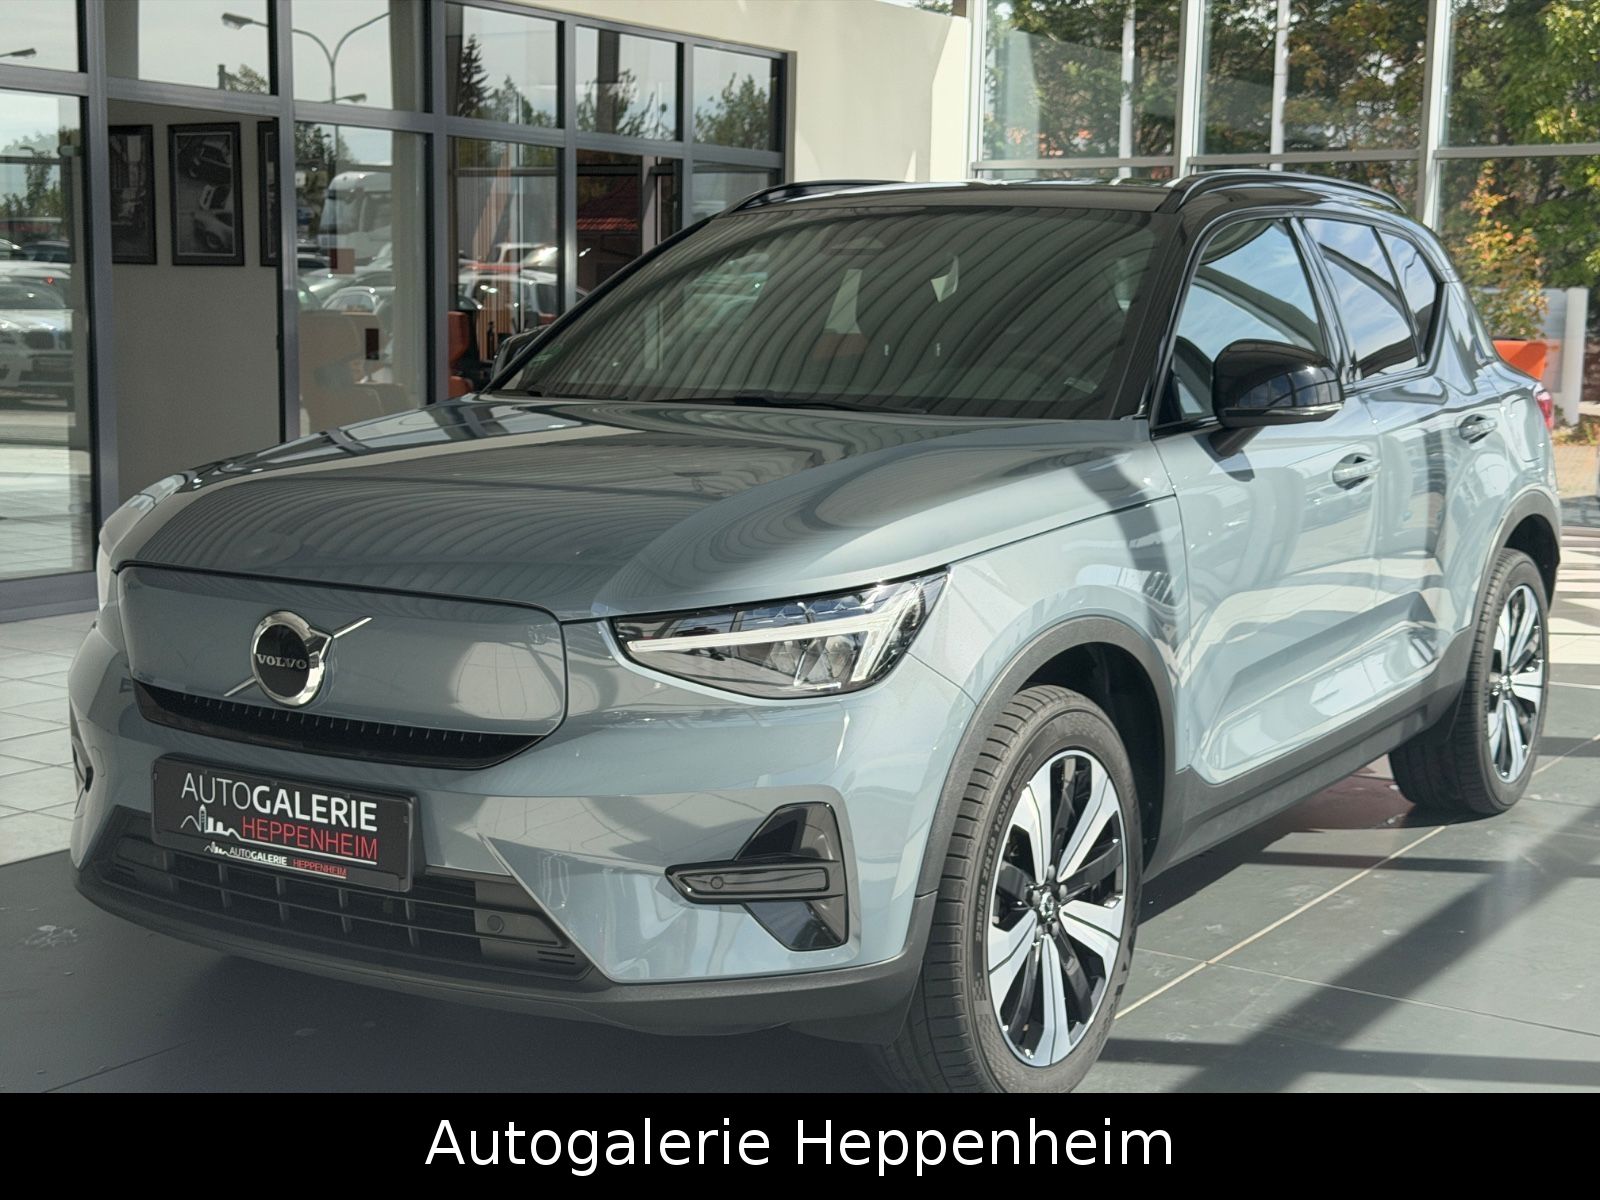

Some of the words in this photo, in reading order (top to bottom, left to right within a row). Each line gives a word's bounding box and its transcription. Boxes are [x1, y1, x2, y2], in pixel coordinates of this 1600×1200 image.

[257, 653, 307, 670] VOLVO
[181, 772, 378, 832] AUTOGALERIE
[242, 816, 378, 860] HEPPENHEIM
[229, 847, 288, 866] AUTOGALERIE
[293, 858, 347, 876] HEPPENHEIM
